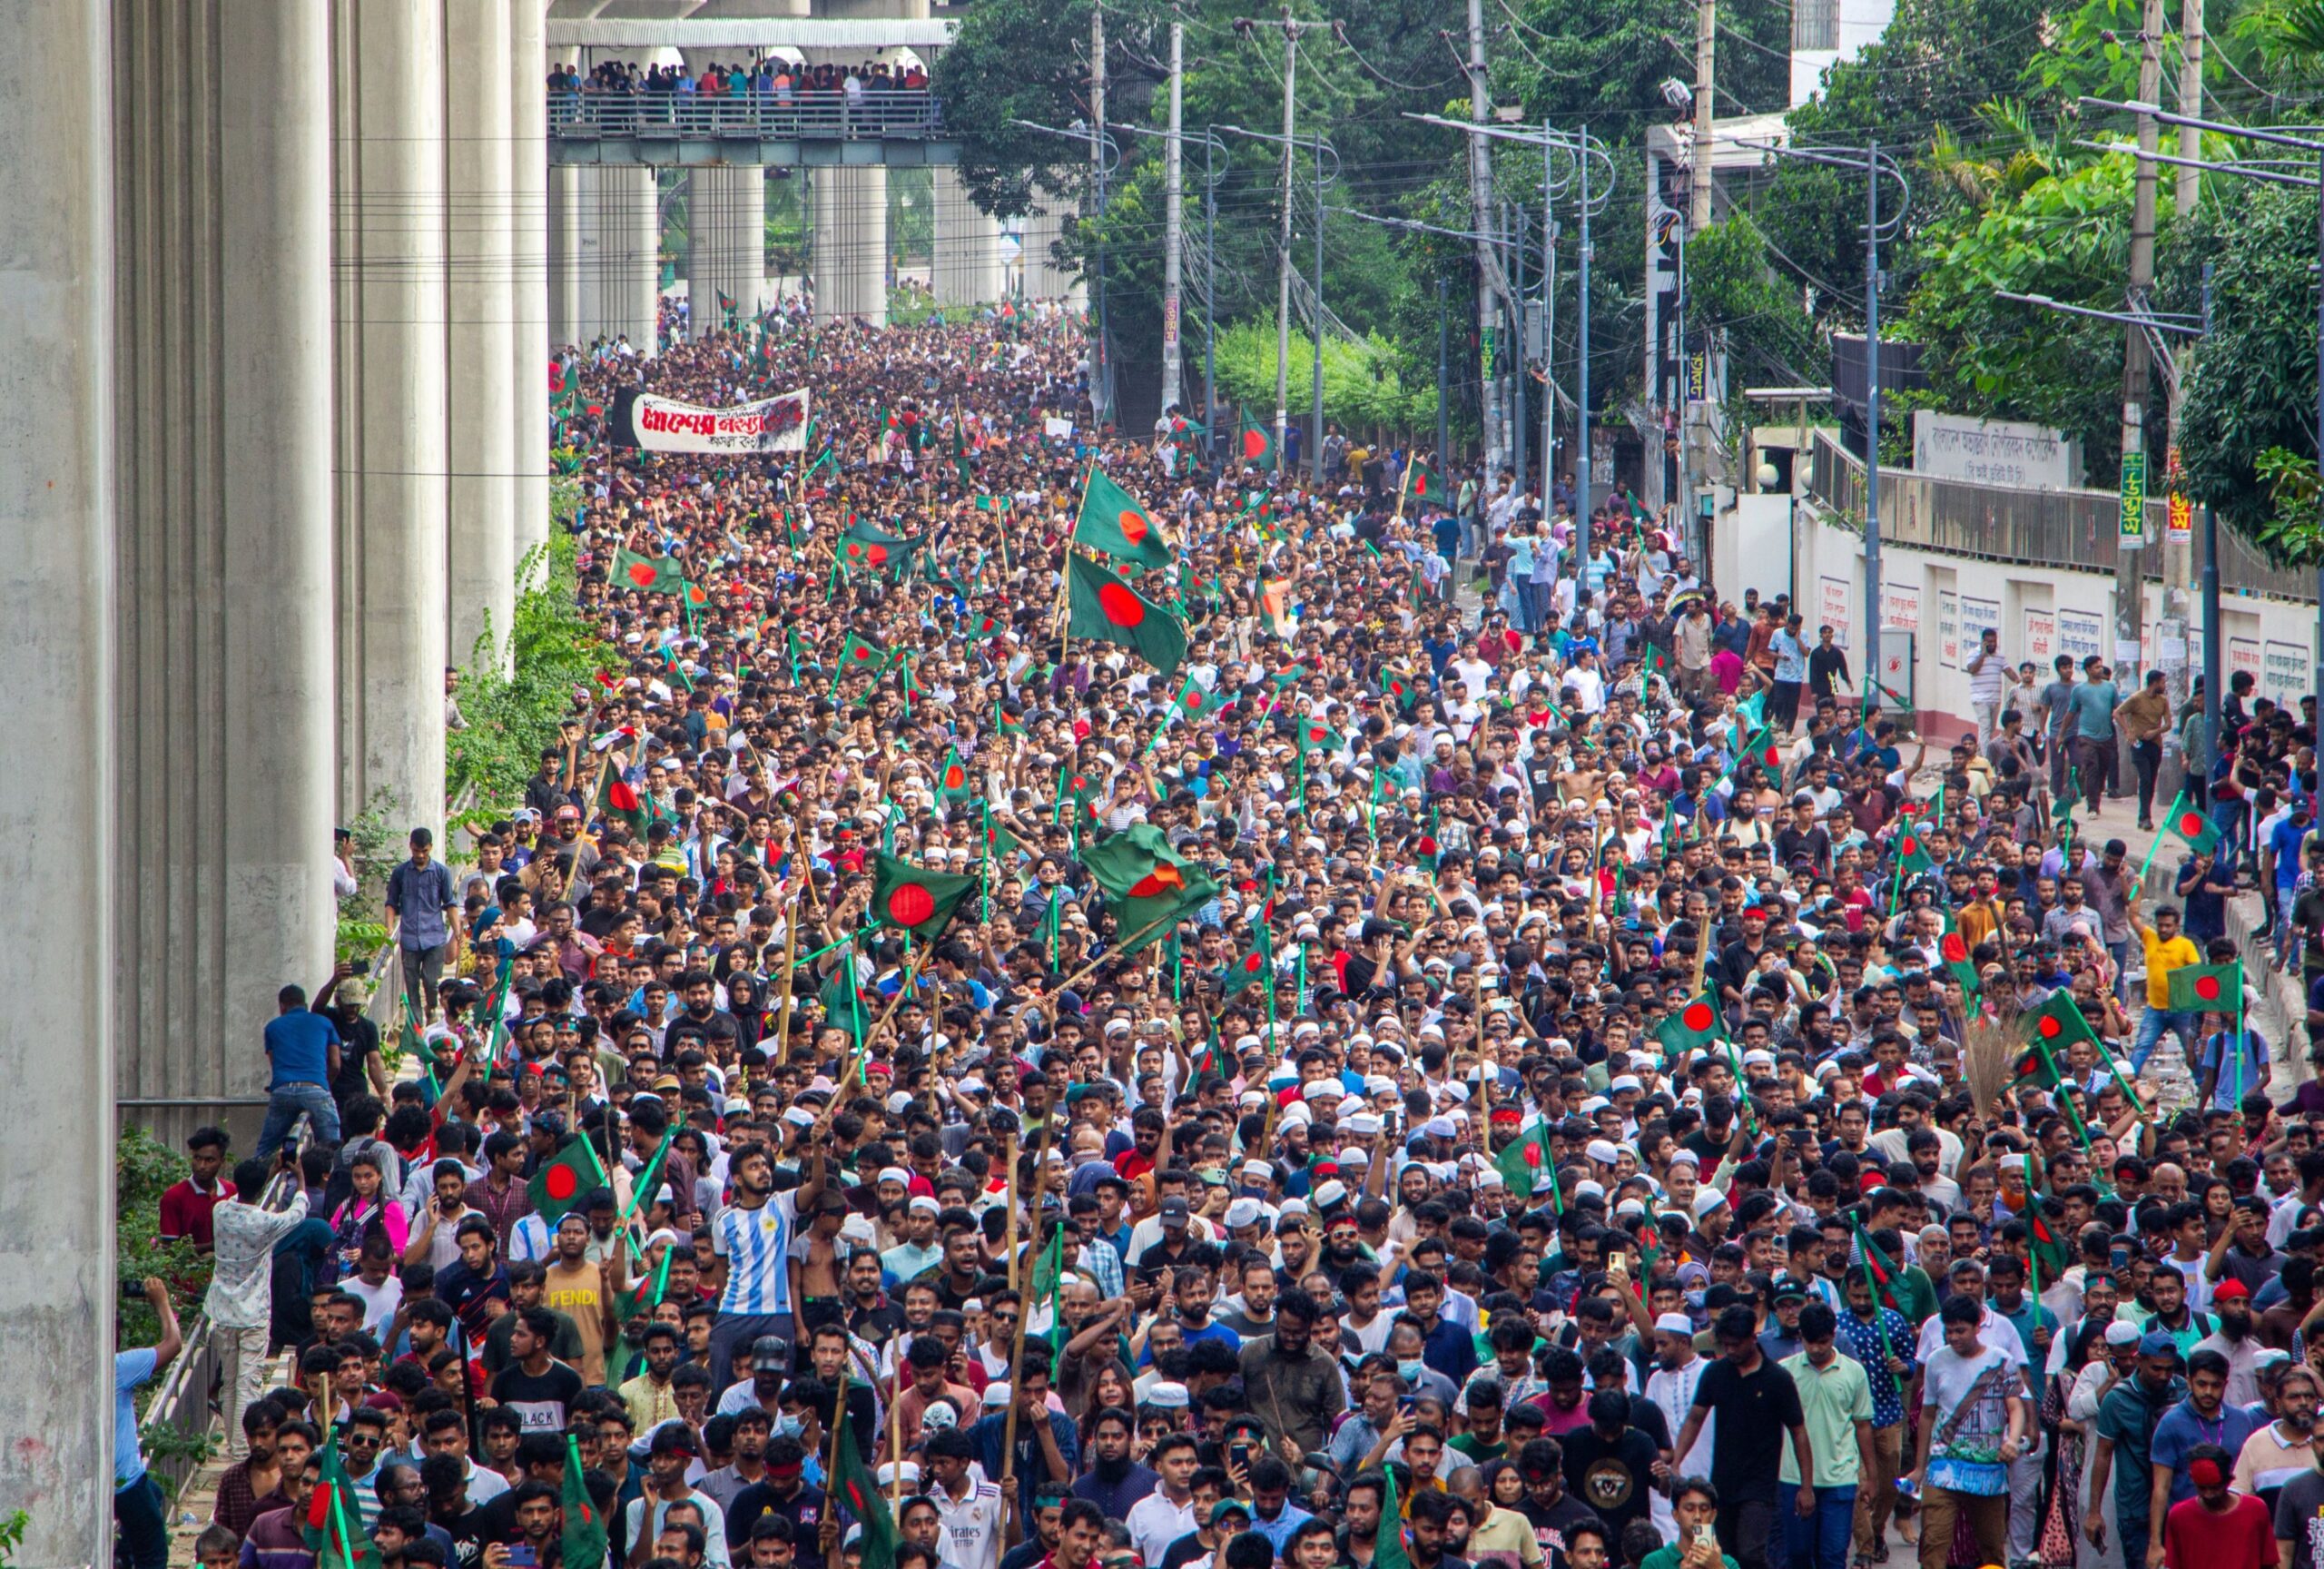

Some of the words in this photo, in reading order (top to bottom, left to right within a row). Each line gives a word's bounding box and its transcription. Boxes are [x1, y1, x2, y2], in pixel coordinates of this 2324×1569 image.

[642, 408, 716, 435] লাশের
[1932, 427, 1960, 453] বাংলাদেশ
[550, 1289, 597, 1308] FENDI
[950, 1525, 980, 1539] irates
